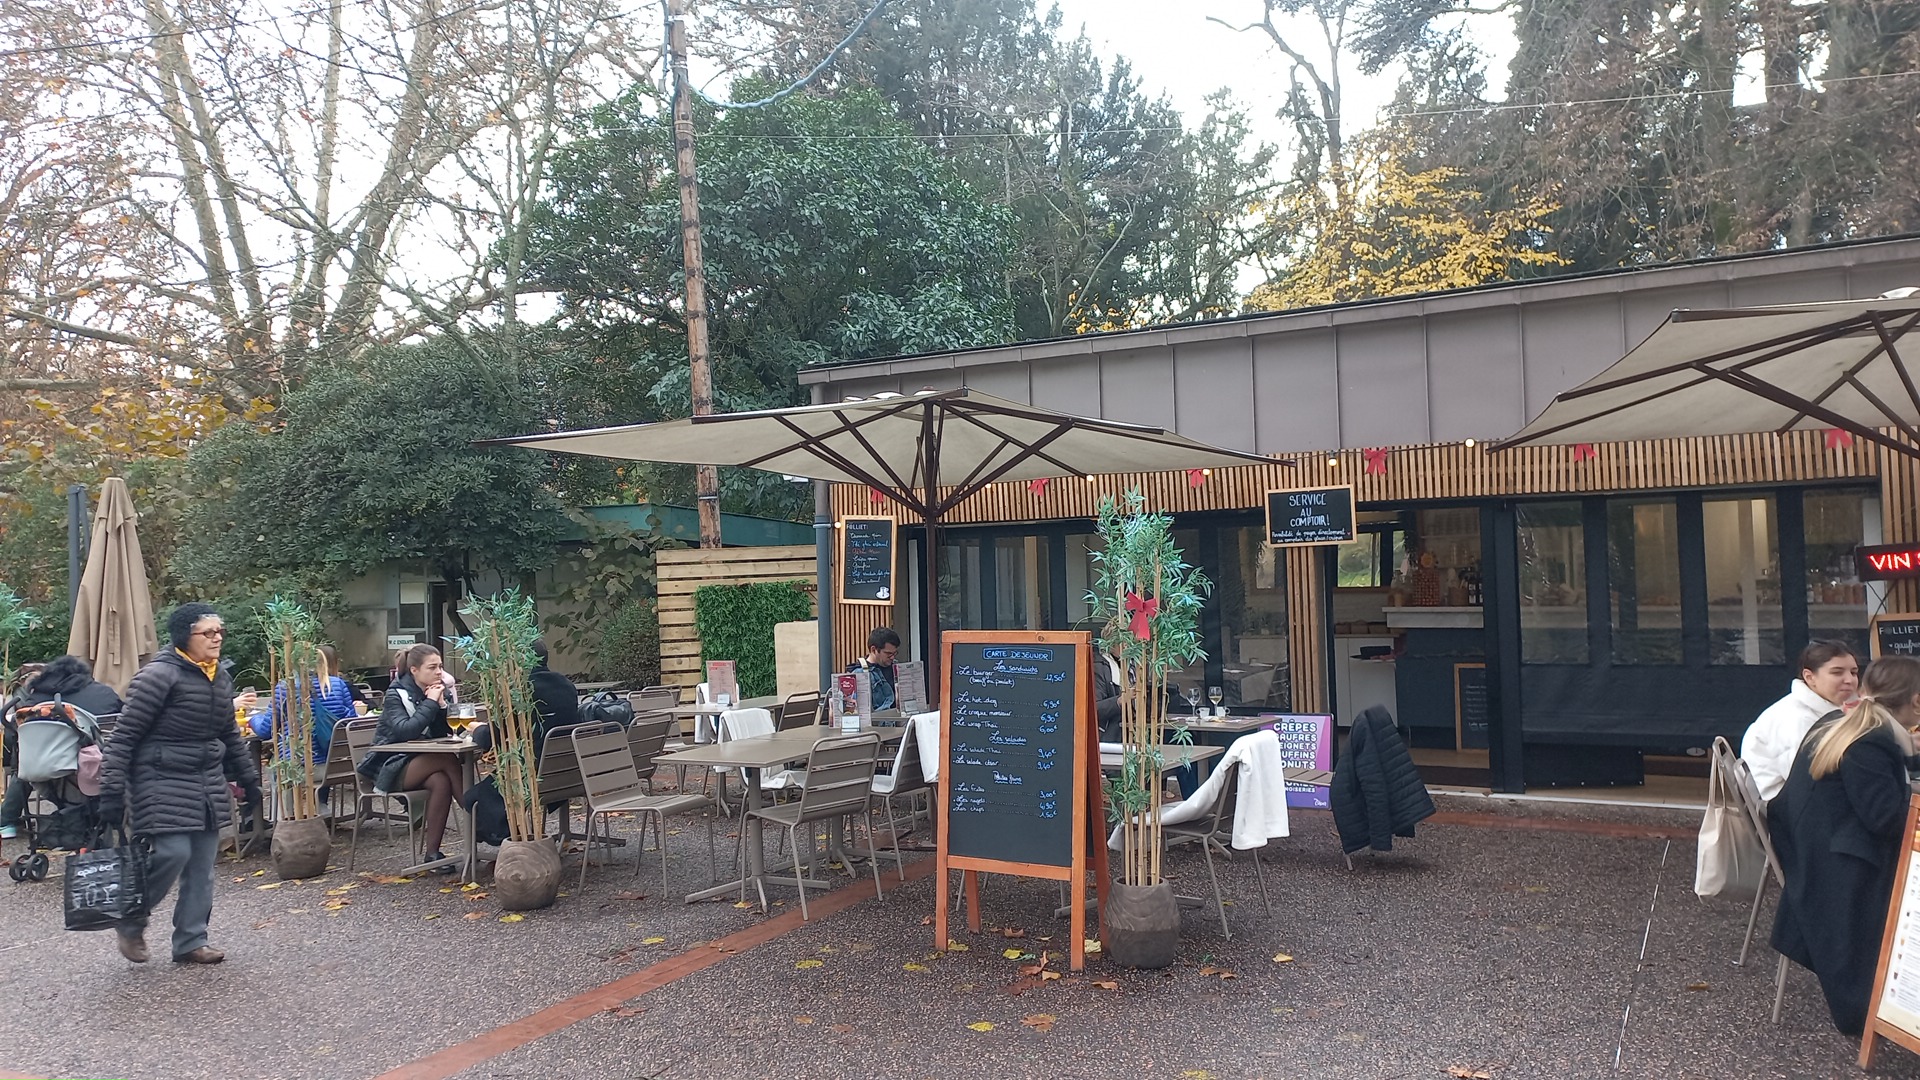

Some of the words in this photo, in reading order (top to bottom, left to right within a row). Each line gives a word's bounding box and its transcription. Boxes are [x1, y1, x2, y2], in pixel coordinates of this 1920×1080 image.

[1289, 493, 1326, 507] SERVICE
[1300, 507, 1312, 517] AU
[1317, 528, 1345, 536] directement
[1870, 553, 1910, 570] VIN
[986, 650, 1007, 658] CARTE
[993, 660, 1006, 671] Les
[958, 665, 972, 675] Le
[972, 667, 994, 679] burger
[957, 691, 971, 703] Le
[956, 705, 968, 716] Le
[968, 709, 988, 717] croque
[955, 716, 967, 727] Le
[1273, 719, 1316, 732] CRÊPES
[989, 730, 1003, 742] Les
[1279, 733, 1316, 741] AUFRES
[1282, 751, 1315, 759] UFFINS
[966, 758, 983, 766] salade
[1281, 760, 1315, 769] ONUTS
[957, 782, 969, 792] Les
[956, 794, 968, 803] Les
